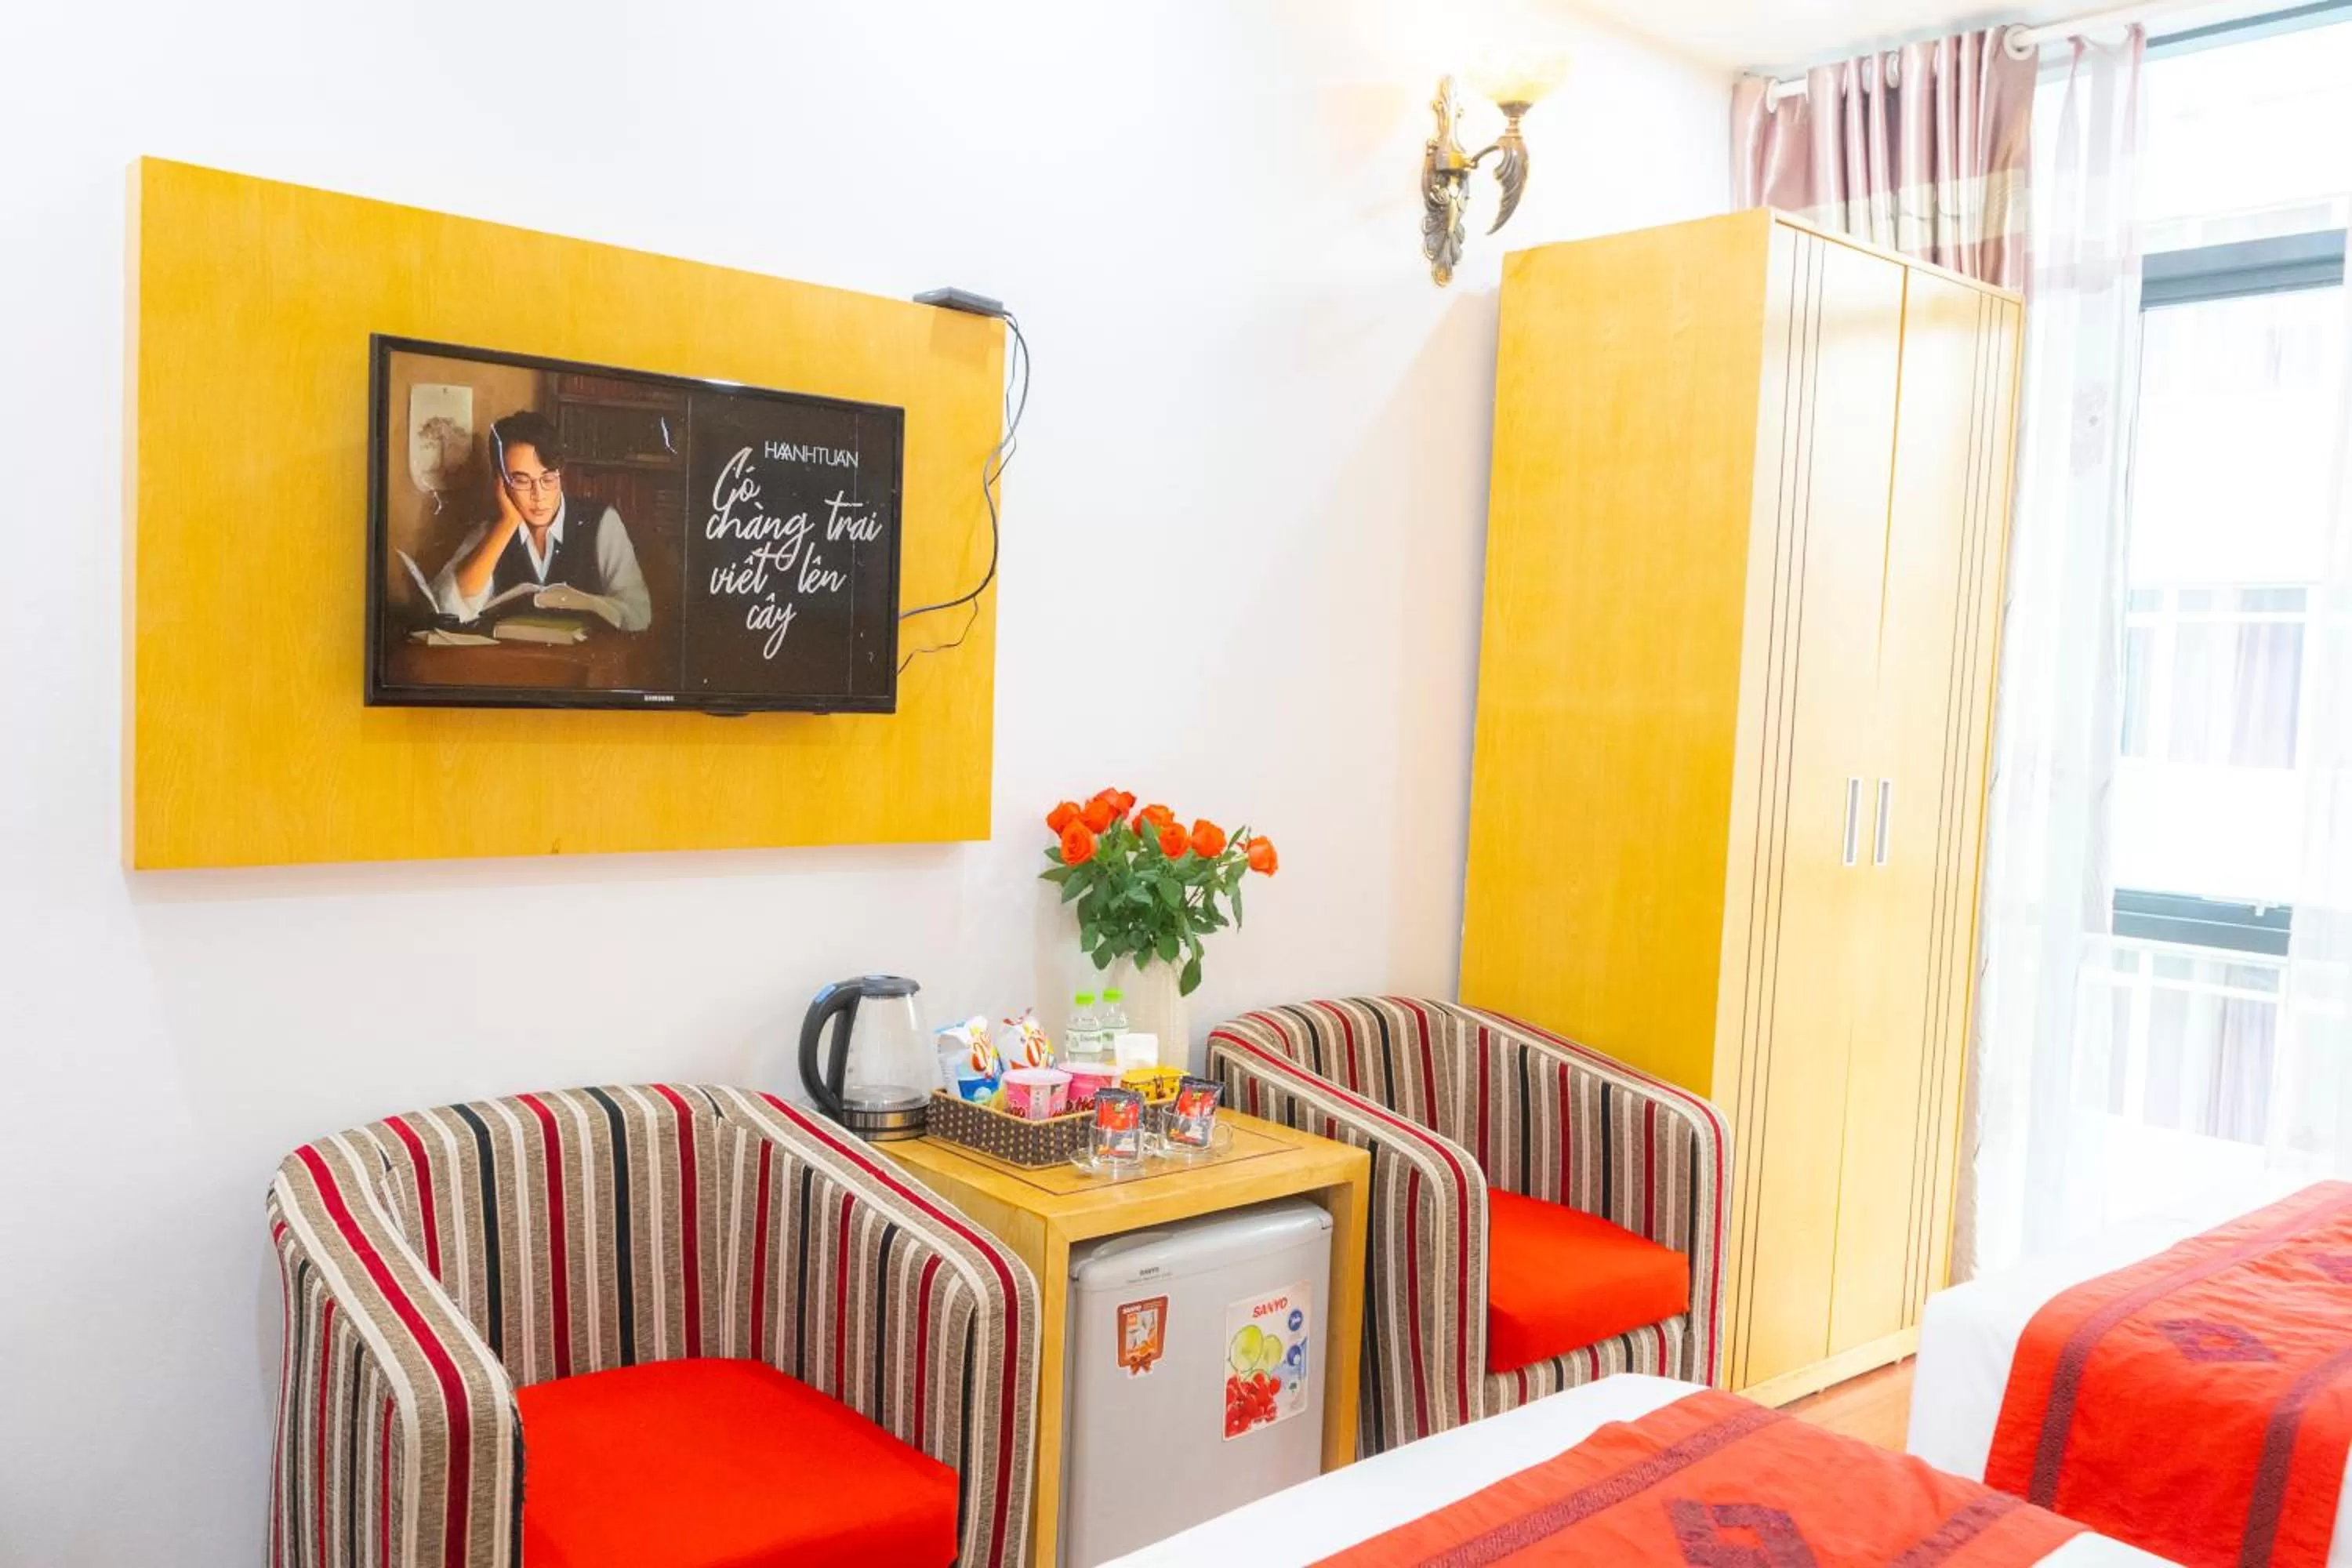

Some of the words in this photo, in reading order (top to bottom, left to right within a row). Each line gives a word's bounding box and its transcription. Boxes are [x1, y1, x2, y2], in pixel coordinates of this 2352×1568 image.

[706, 503, 815, 572] chàng
[824, 490, 883, 542] trai
[797, 541, 848, 594] lên
[746, 592, 797, 661] cây
[1253, 1297, 1288, 1318] SANYO
